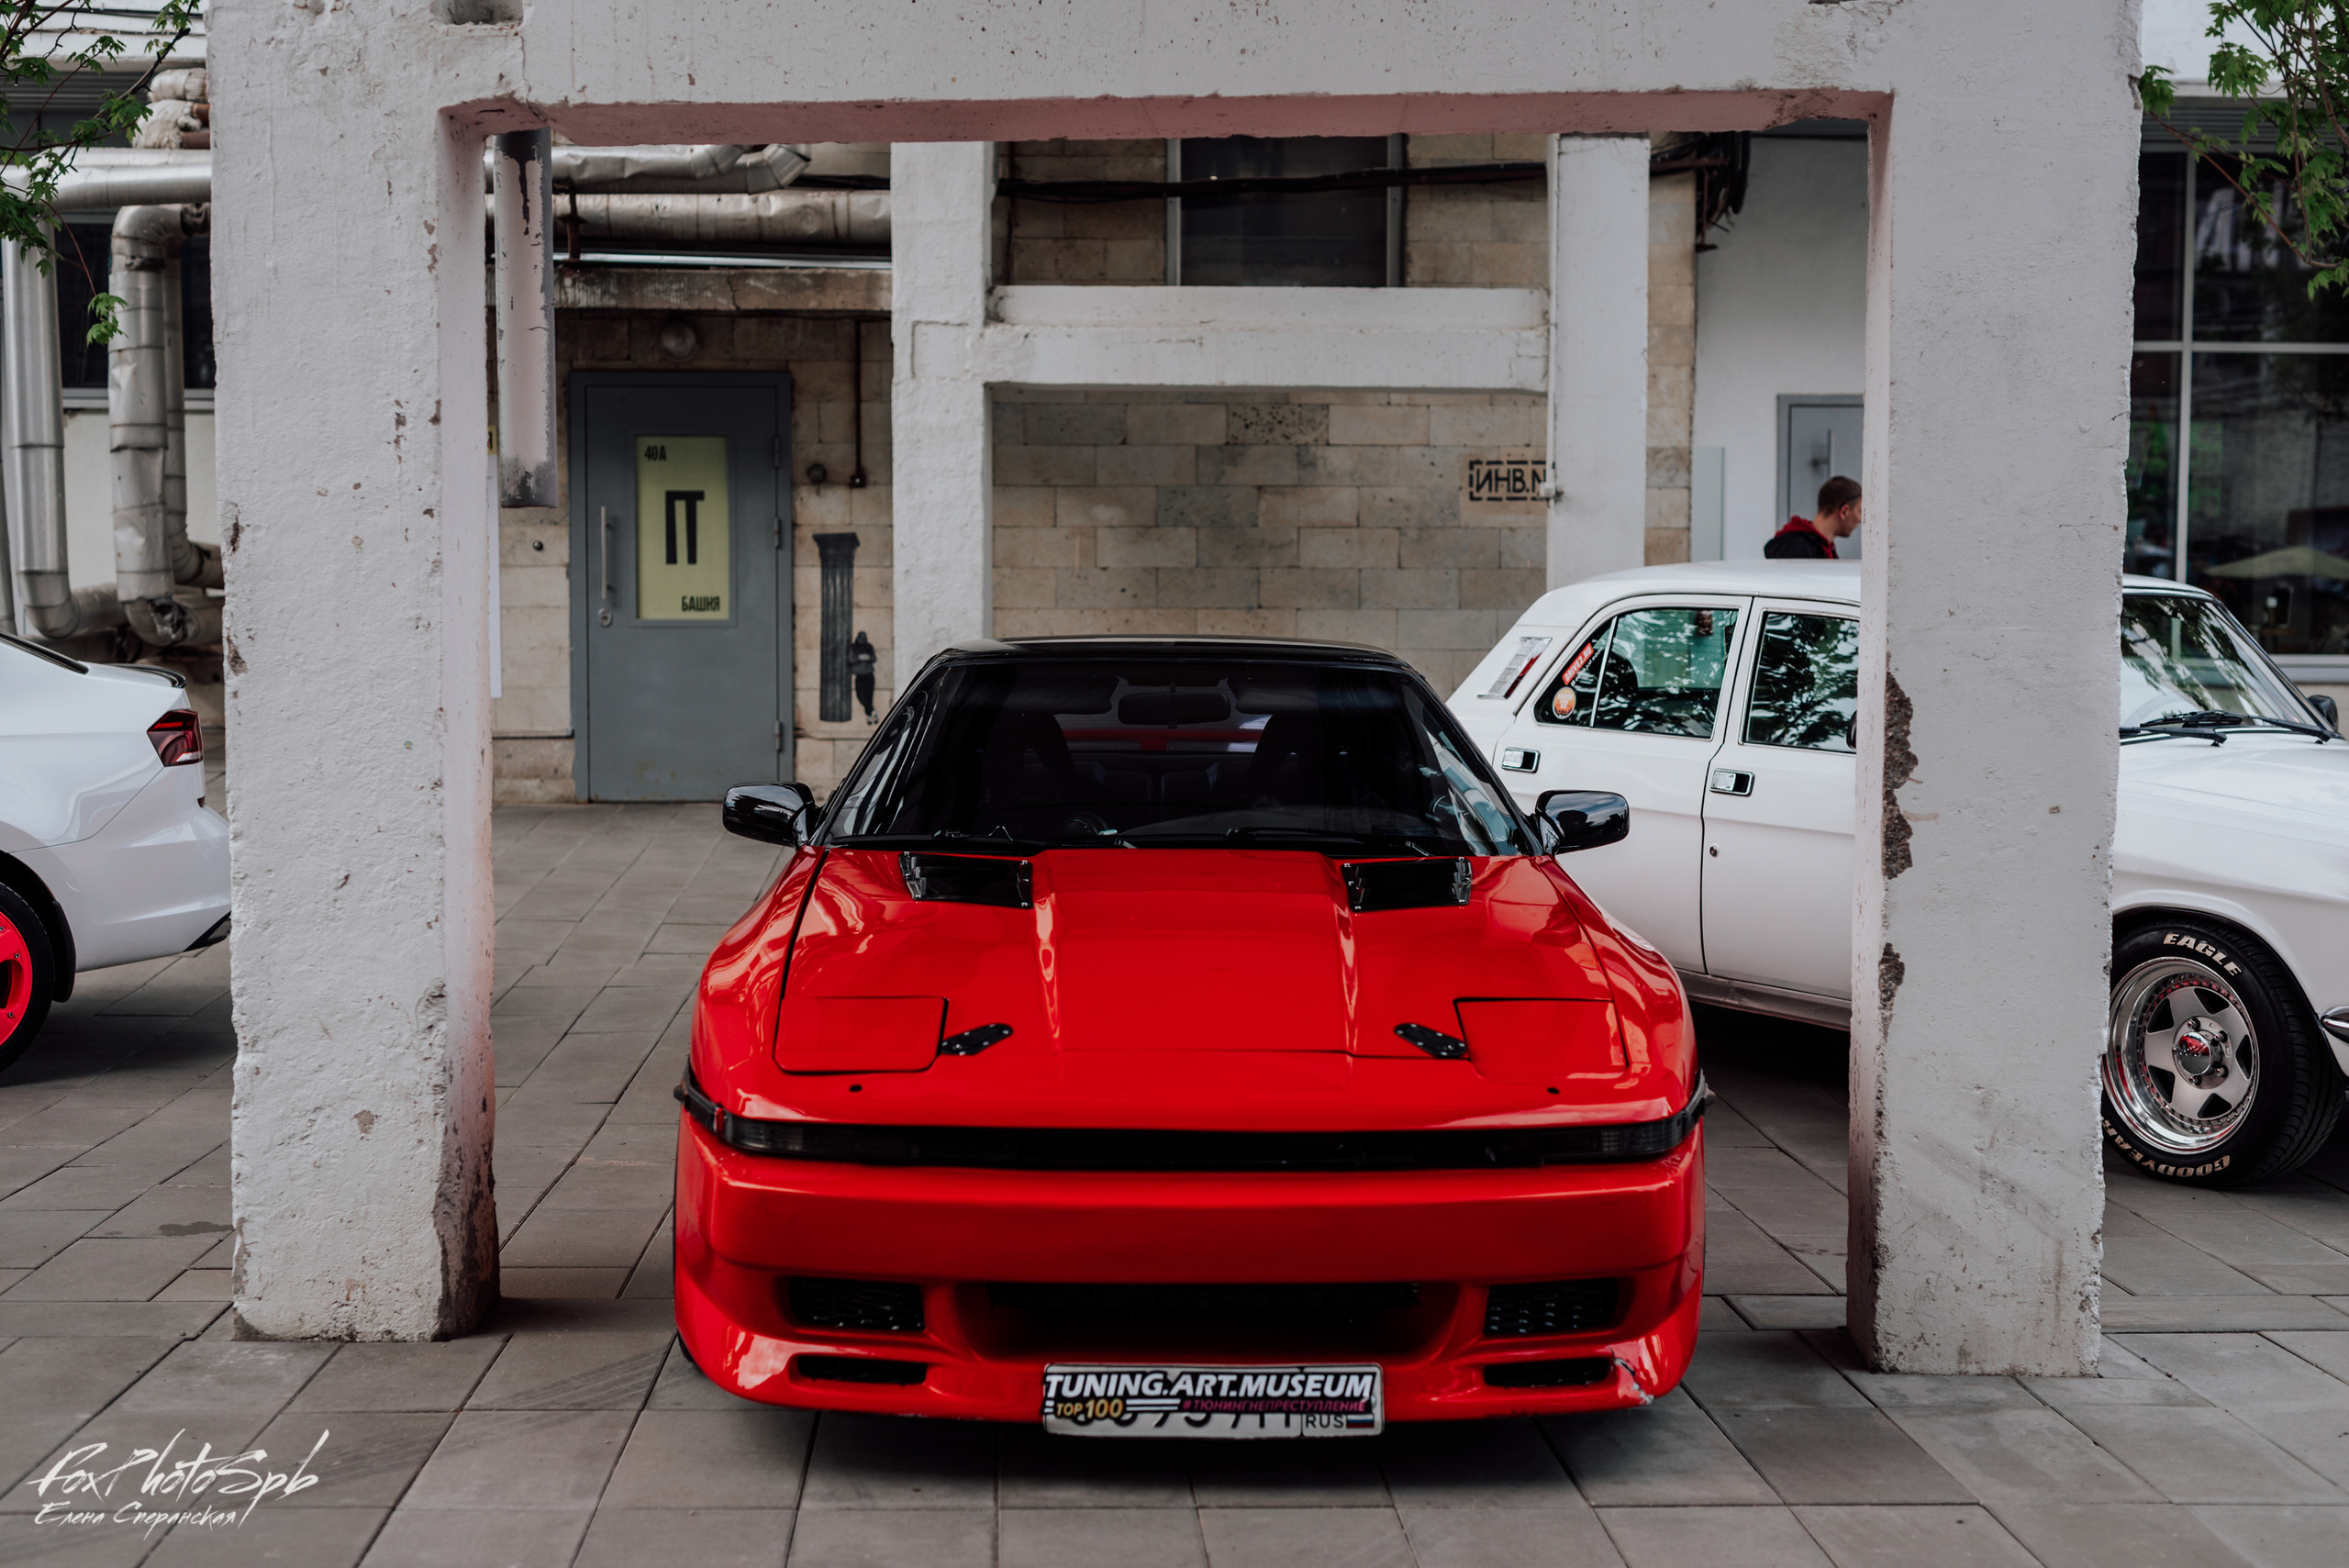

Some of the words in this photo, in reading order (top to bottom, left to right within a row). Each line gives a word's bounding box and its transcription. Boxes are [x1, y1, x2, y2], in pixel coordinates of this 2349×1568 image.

[644, 445, 667, 462] 40А
[682, 596, 720, 612] БАШНЯ
[1564, 645, 1592, 683] DRIVE2.RU
[2163, 933, 2242, 977] EAGLE
[1045, 1373, 1373, 1398] TUNING.ART.MUSEUM
[1056, 1402, 1084, 1417] TOP
[1085, 1398, 1124, 1419] 100
[1305, 1414, 1344, 1429] RUS
